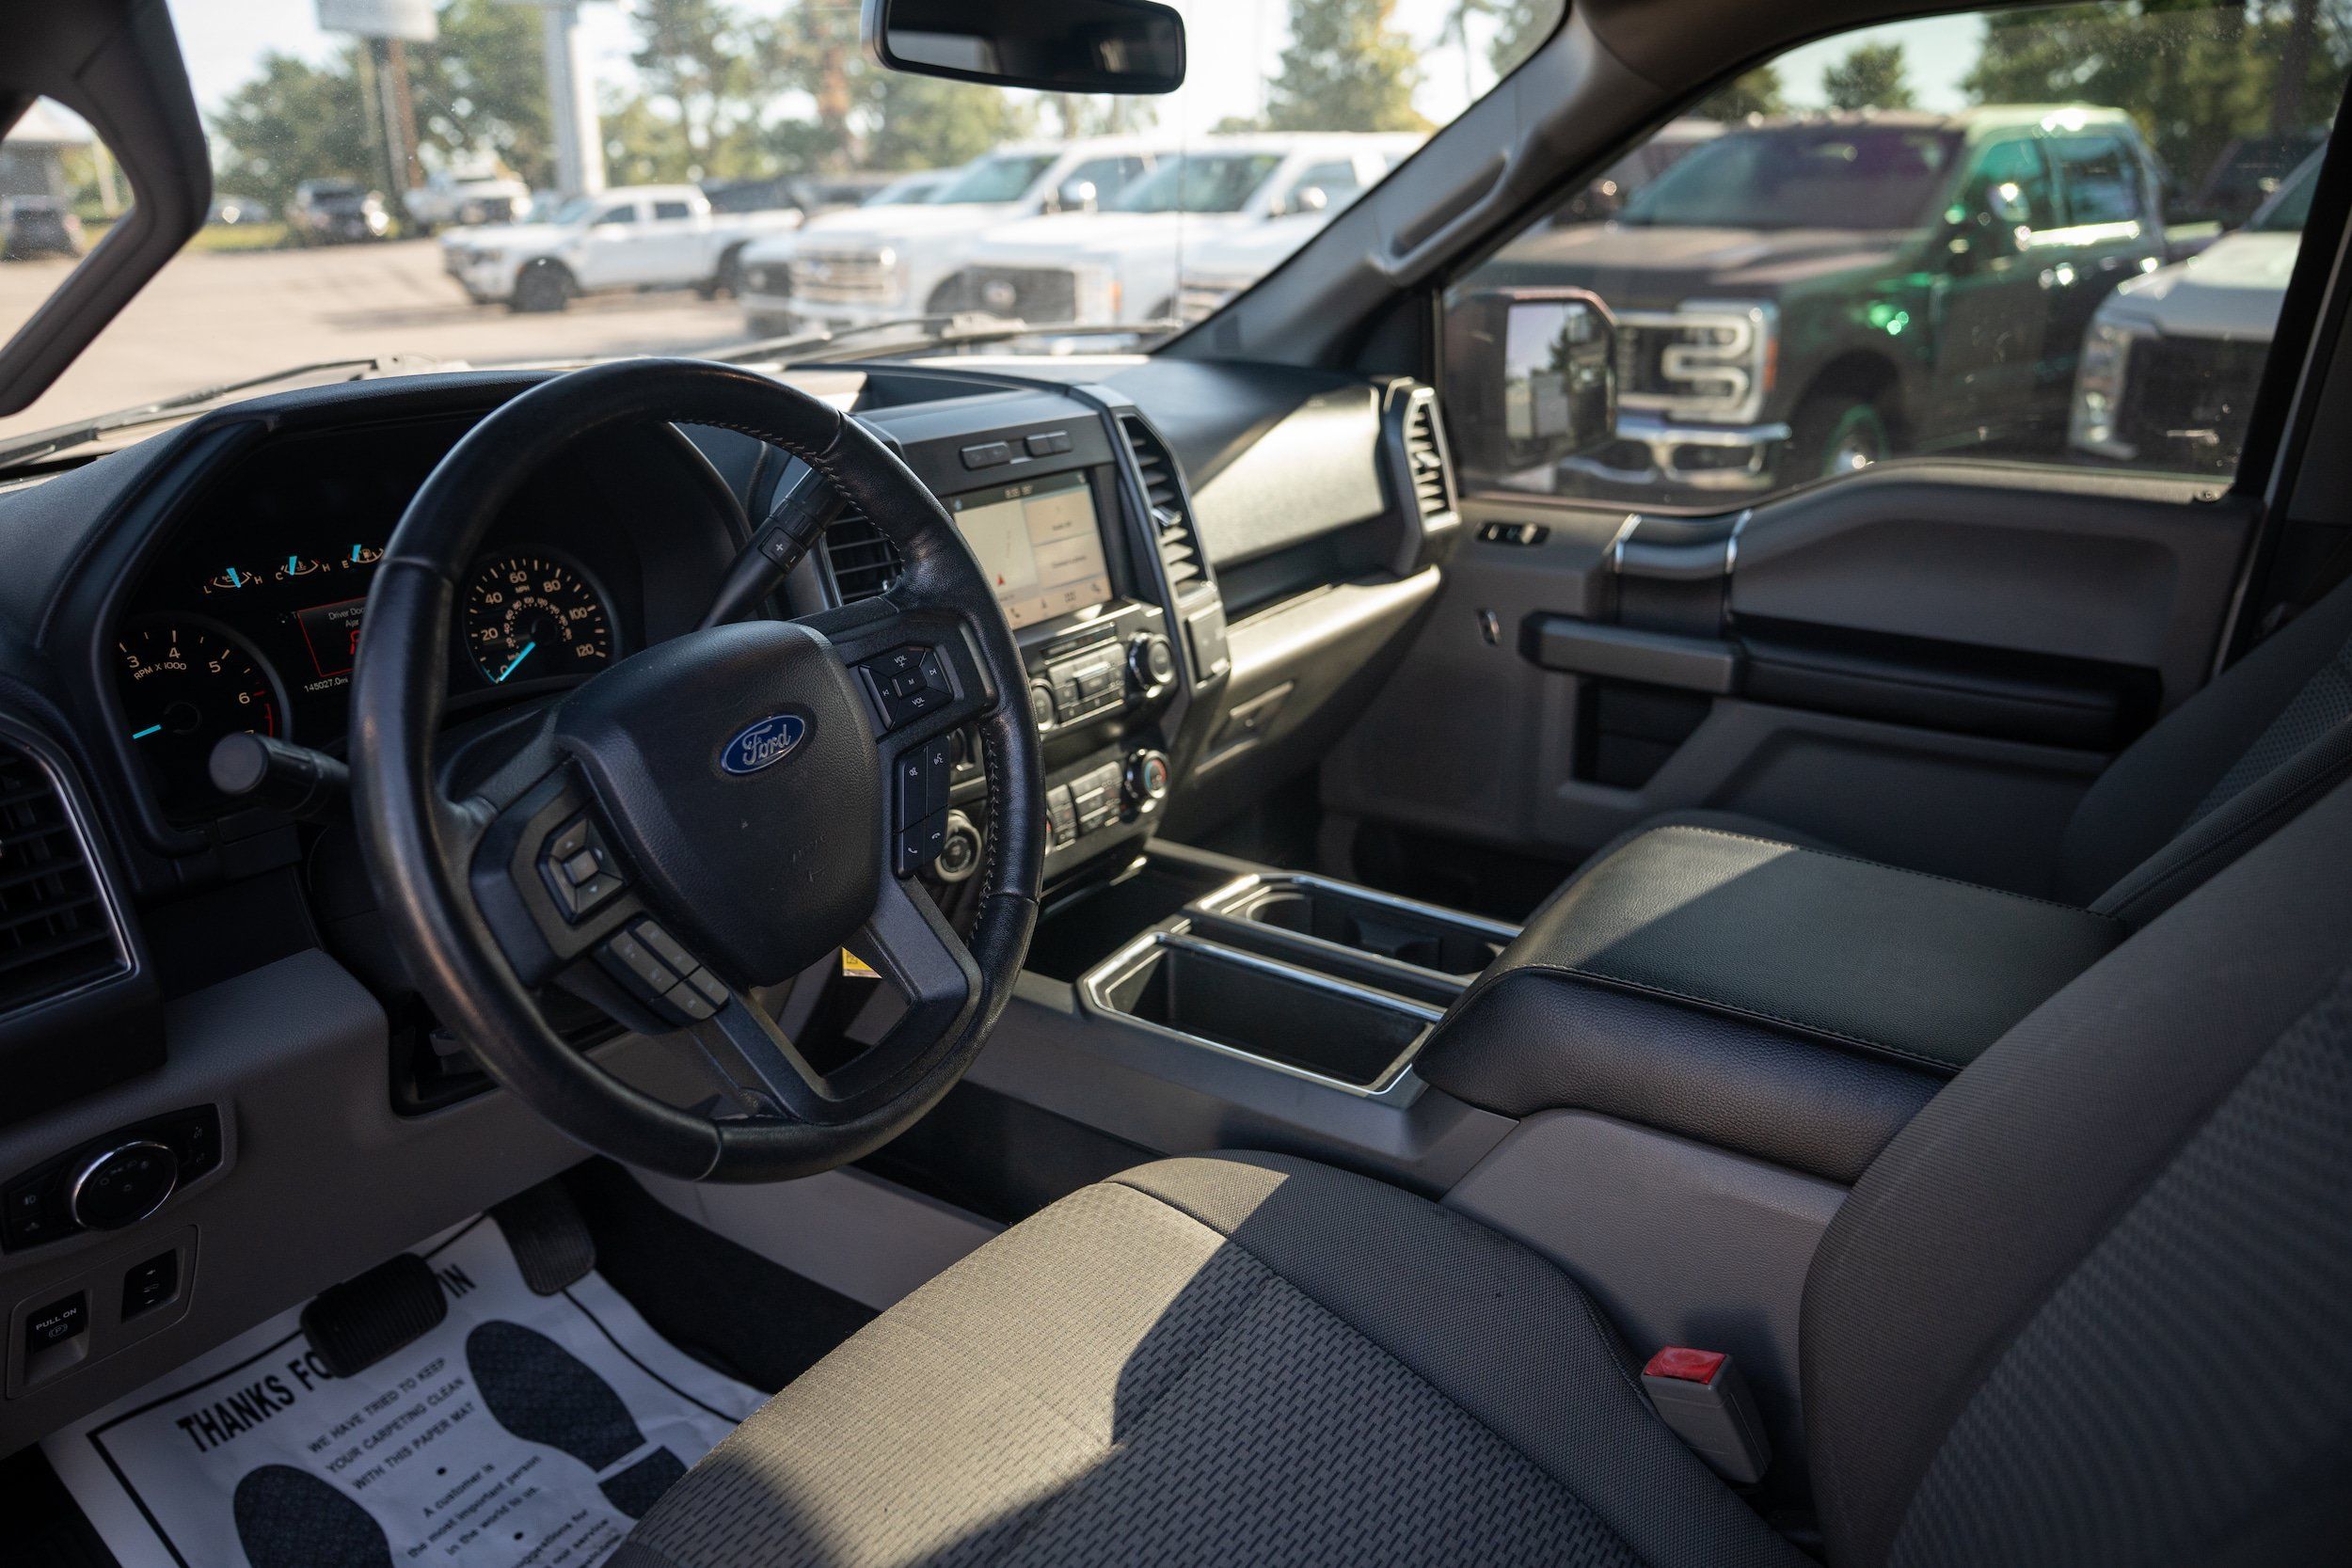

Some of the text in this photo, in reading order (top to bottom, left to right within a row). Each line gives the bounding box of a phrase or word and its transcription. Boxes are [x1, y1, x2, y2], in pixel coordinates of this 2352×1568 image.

[275, 562, 331, 580] C H
[341, 560, 350, 569] E
[203, 575, 263, 594] L H
[508, 570, 528, 584] 60
[515, 584, 531, 594] MPH
[543, 579, 562, 593] 80
[485, 591, 503, 604] 40
[327, 610, 350, 621] Driver
[568, 607, 588, 621] 100
[481, 627, 499, 641] 20
[168, 646, 182, 659] 4
[576, 642, 595, 658] 120
[126, 655, 140, 669] 3
[208, 660, 221, 674] 5
[134, 666, 153, 681] RPM
[164, 661, 187, 671] 1000
[908, 677, 916, 686] M
[239, 691, 251, 705] 6
[741, 723, 791, 766] Ford
[36, 1307, 77, 1331] PULL ON
[176, 1375, 294, 1452] THANKS
[287, 1351, 331, 1391] FO
[309, 1356, 446, 1453] WE HAVE TRIED TO KEEP
[326, 1376, 465, 1474] YOUR CARPETING CLEAN
[352, 1401, 475, 1491] WITH THIS PAPER MAT
[435, 1471, 482, 1511] customer
[407, 1455, 543, 1559] the most important person
[459, 1528, 480, 1545] the
[480, 1505, 511, 1529] world
